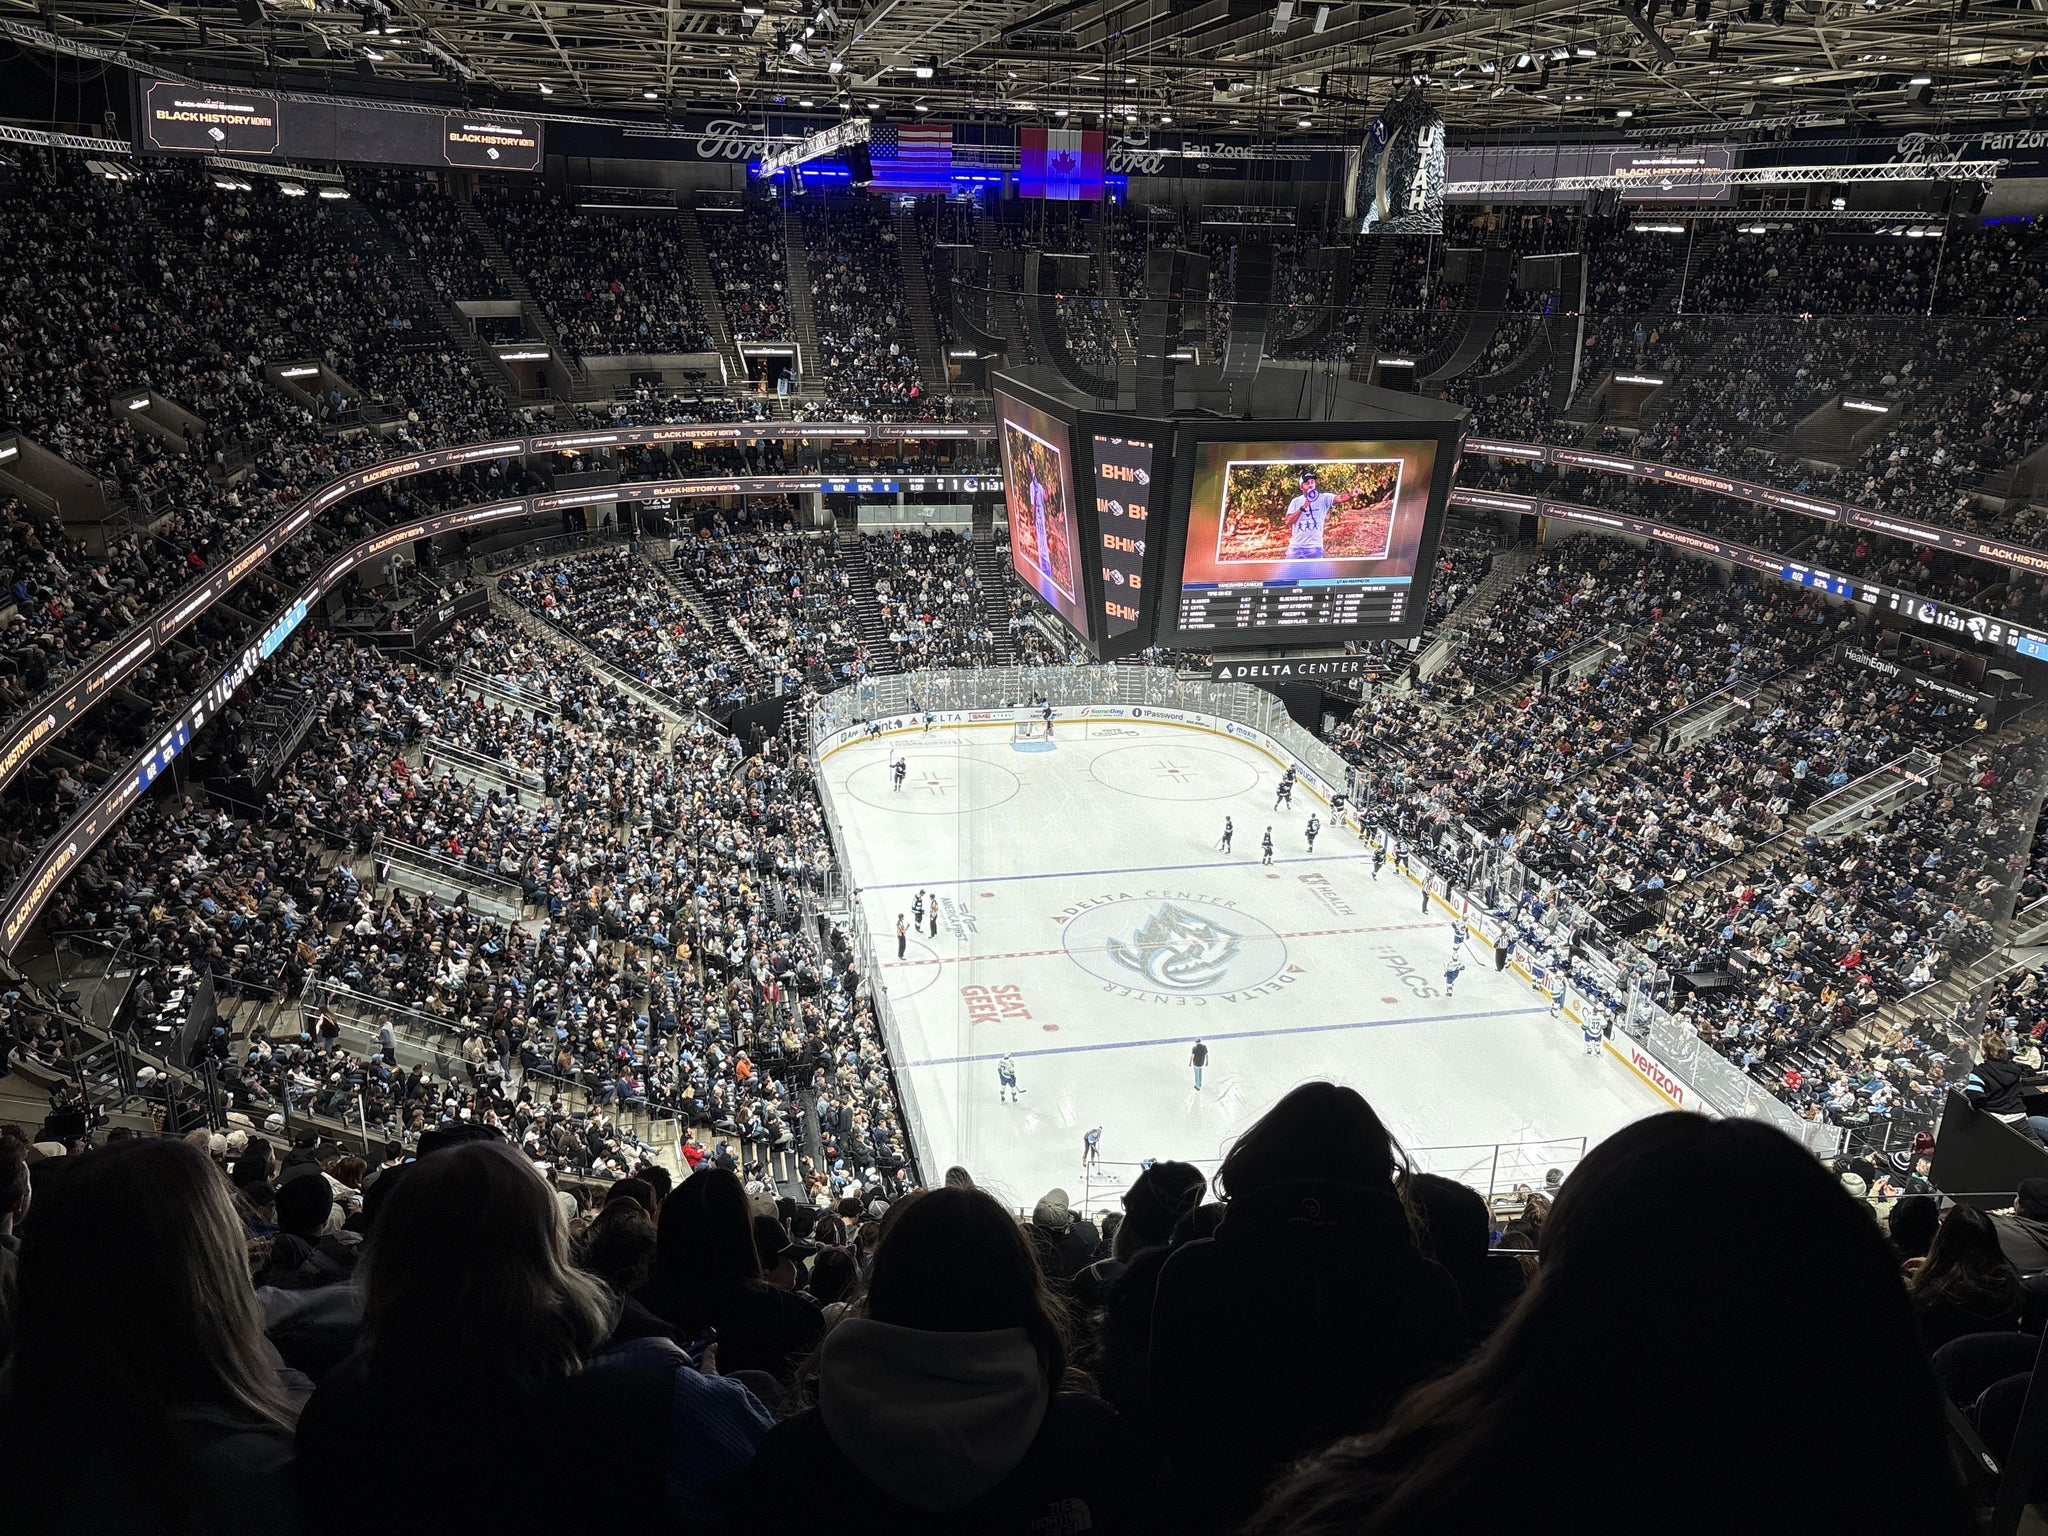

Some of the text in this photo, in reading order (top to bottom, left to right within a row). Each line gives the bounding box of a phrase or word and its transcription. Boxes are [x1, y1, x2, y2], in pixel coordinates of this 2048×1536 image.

[156, 110, 272, 127] BLACK HISTORY MONTH
[449, 132, 481, 143] BLACK
[481, 135, 519, 146] HISTORY
[1981, 130, 2048, 151] Fan Zon
[1182, 141, 1251, 159] Fan Zone
[1408, 126, 1435, 211] UTAH
[1615, 168, 1652, 176] BLACK
[1652, 167, 1700, 176] HISTORY
[653, 431, 681, 439] BLACK
[682, 430, 718, 439] HISTORY
[362, 465, 403, 483] BLACK HISTORY
[1101, 463, 1134, 483] BHM
[1664, 469, 1717, 488] BLACK HISTORY
[653, 486, 681, 495] BLACK
[682, 485, 719, 493] HISTORY
[858, 484, 873, 492] 52%
[952, 479, 1004, 491] 1 11:31
[369, 532, 408, 553] BLACK HISTORY
[1103, 533, 1135, 553] BHM
[1652, 529, 1704, 548] BLACK HISTORY
[1979, 544, 2048, 570] BLACK HISTOR
[1792, 572, 1804, 582] 0/2
[1813, 578, 1828, 590] 52%
[1837, 585, 1843, 594] 6
[1862, 592, 1877, 605] 2:00
[1105, 601, 1135, 622] BHM
[1906, 599, 1965, 632] 1 11:31
[1988, 624, 2001, 642] 2
[2007, 635, 2039, 655] 10 21
[1236, 661, 1359, 677] DELTA CENTER
[1844, 647, 1901, 678] HealthEquity
[1945, 687, 1979, 703] AMERICA FIRST
[1143, 710, 1184, 721] 1Password
[1236, 726, 1257, 740] moxie
[6, 731, 35, 769] HISTORY
[7, 899, 32, 941] BLACK
[29, 864, 58, 909] HISTORY
[1063, 889, 1236, 915] DELTA CENTER
[1316, 886, 1355, 916] HEALTH
[950, 923, 968, 942] FIRST
[1378, 954, 1440, 999] PACS
[1103, 974, 1296, 1006] DELTA CENTER
[960, 984, 1001, 1025] GEEK
[991, 984, 1033, 1020] SEAT
[1631, 1047, 1683, 1104] verizon
